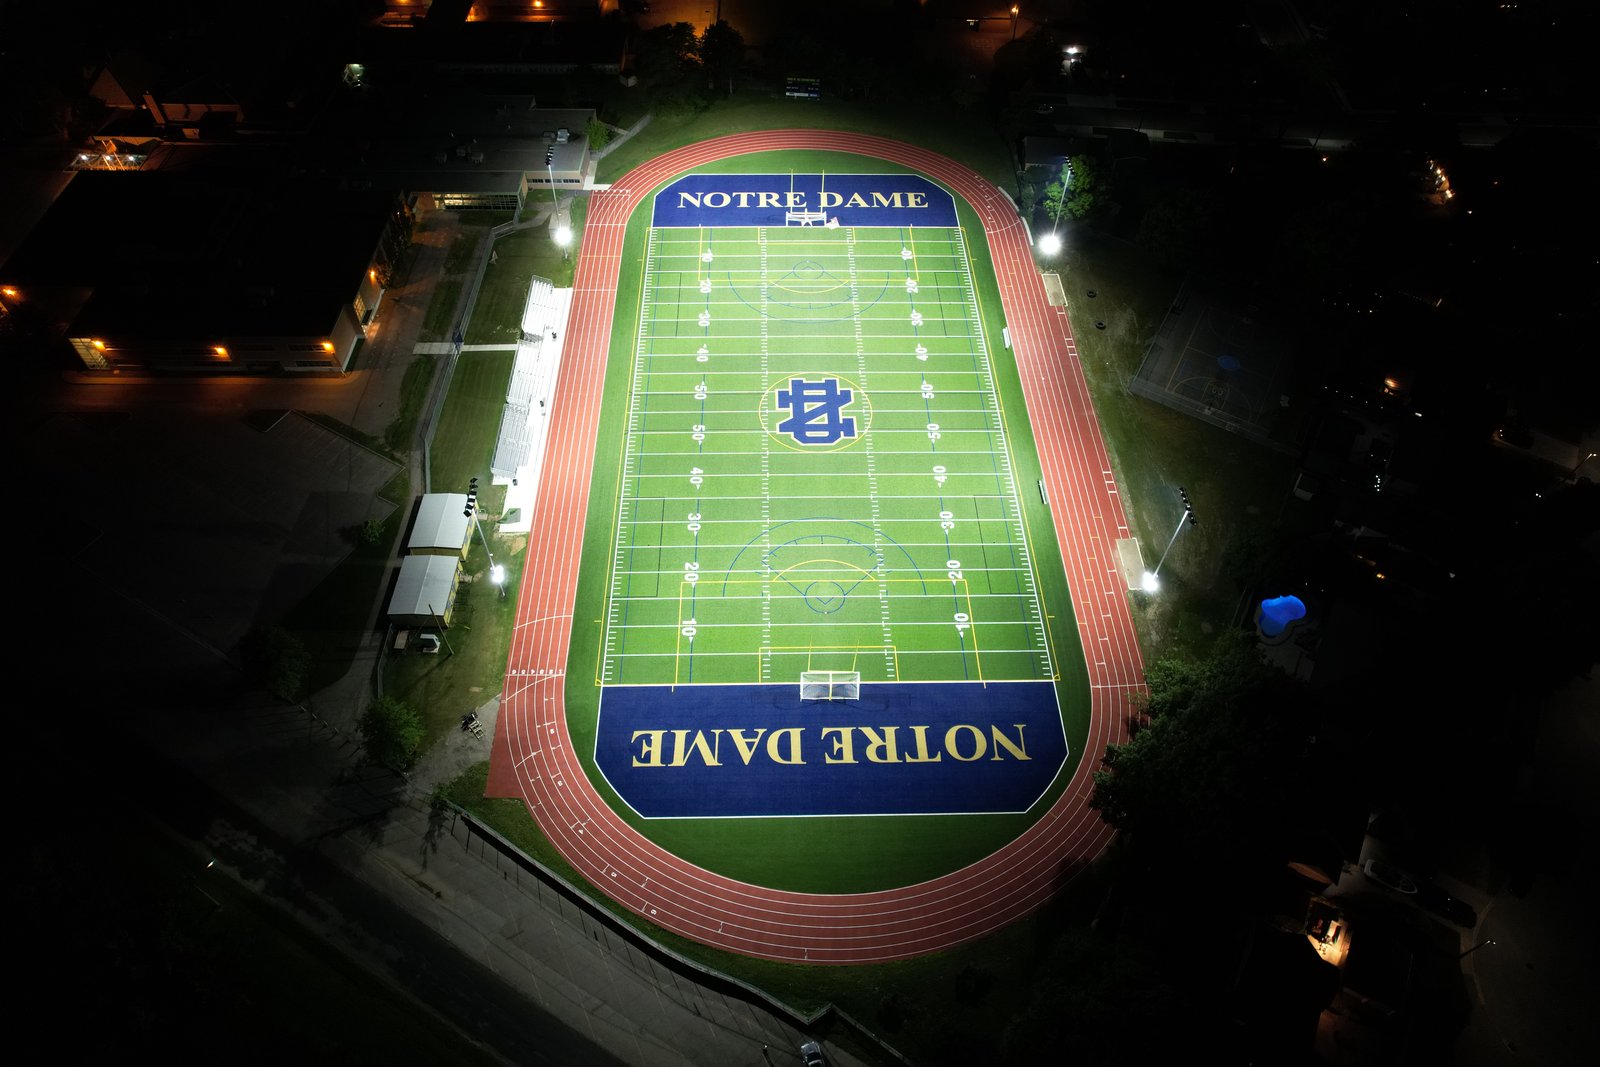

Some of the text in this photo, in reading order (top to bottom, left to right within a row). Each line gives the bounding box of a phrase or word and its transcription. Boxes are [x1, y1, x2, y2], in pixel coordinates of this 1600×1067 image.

[677, 191, 929, 208] NOTRE DAME
[906, 280, 919, 294] 20
[698, 312, 711, 327] 30
[910, 312, 924, 327] 30
[696, 347, 709, 363] 40
[915, 347, 929, 362] 40
[694, 384, 708, 400] 50
[921, 383, 935, 400] 50
[692, 424, 706, 441] 50
[926, 423, 941, 440] 50
[689, 466, 704, 485] 40
[932, 465, 948, 483] 40
[687, 512, 702, 532] 30
[939, 510, 955, 530] 30
[684, 562, 700, 582] 20
[946, 559, 963, 580] 20
[681, 618, 697, 637] 10
[954, 612, 971, 631] 10
[630, 723, 1033, 768] NOTRE DAME
